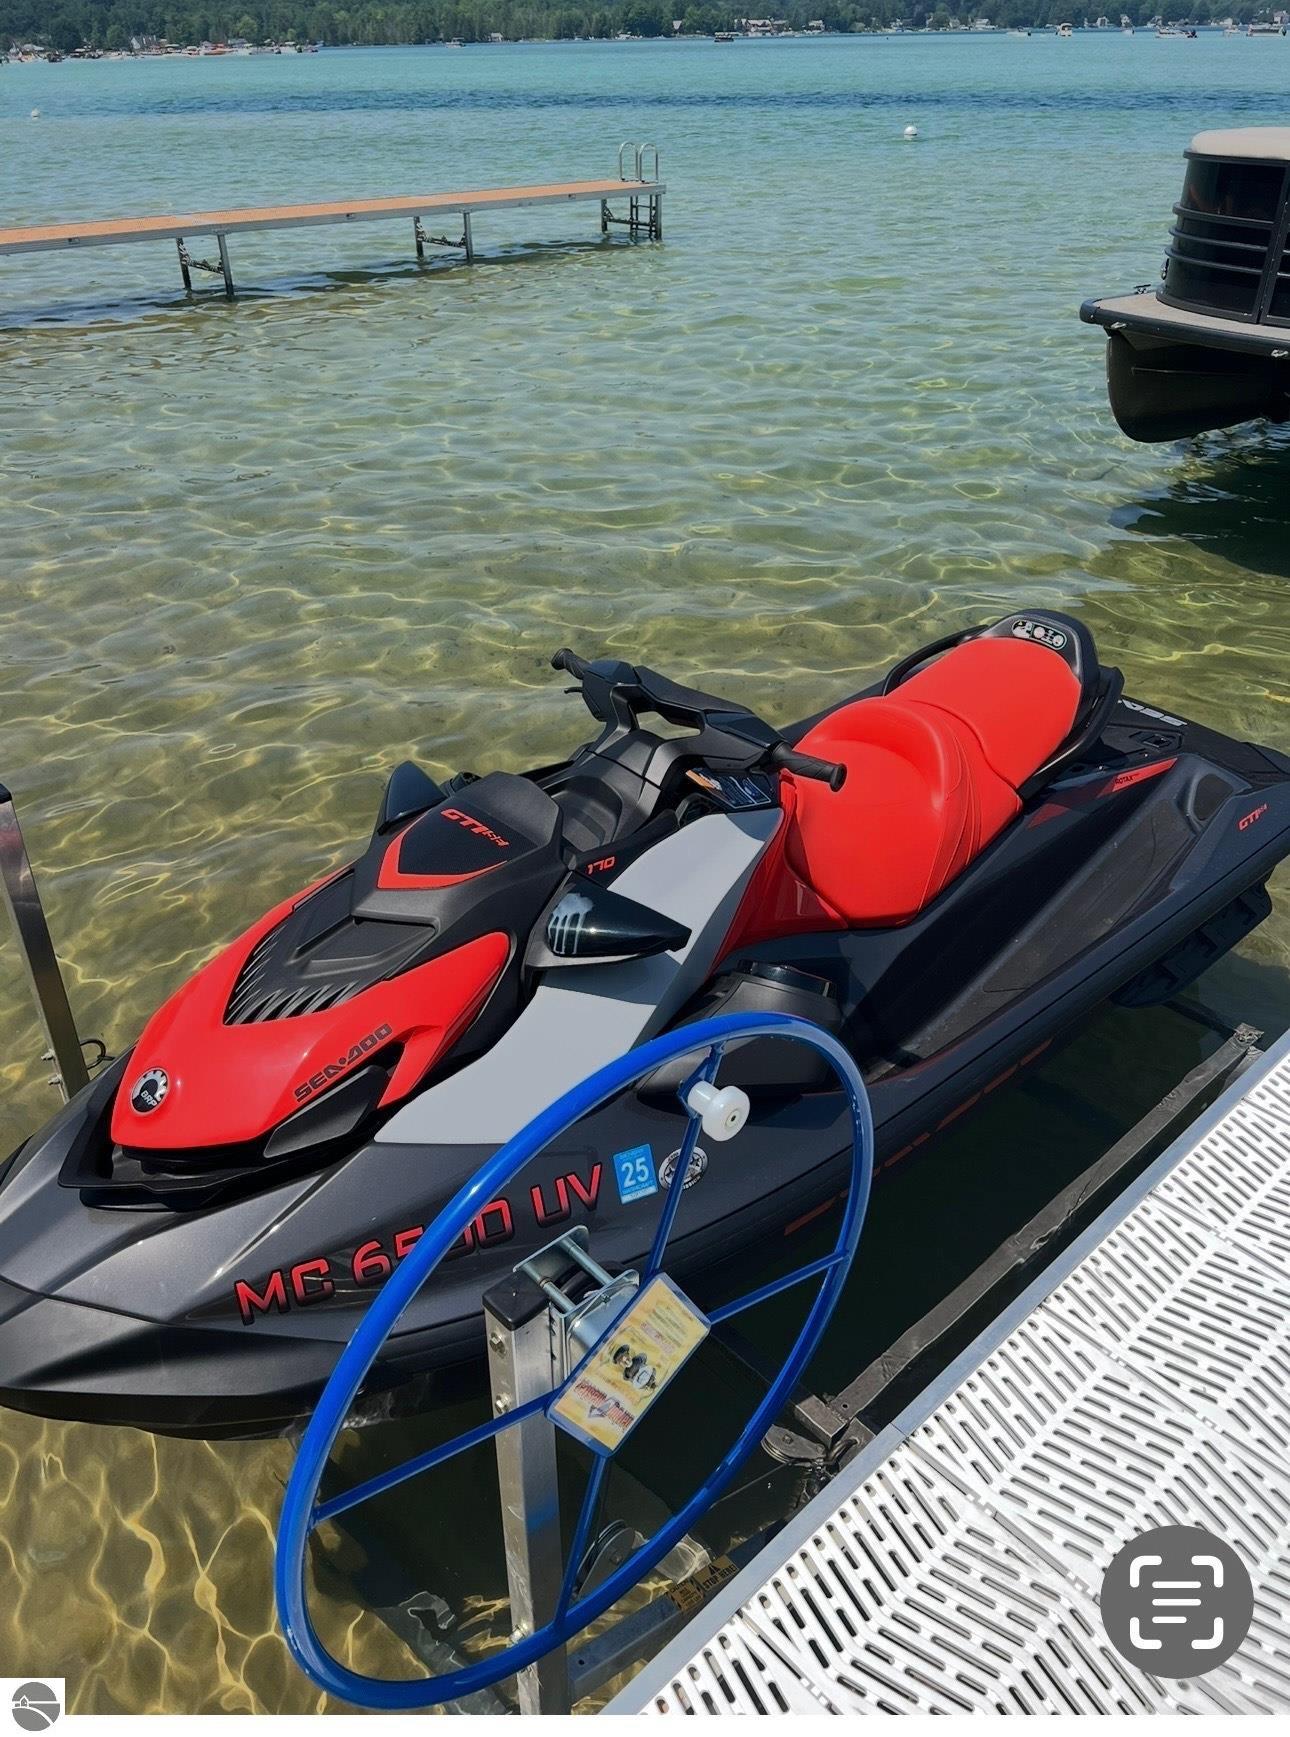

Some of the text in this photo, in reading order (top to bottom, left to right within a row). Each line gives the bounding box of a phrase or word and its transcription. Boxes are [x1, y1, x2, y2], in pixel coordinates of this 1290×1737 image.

[587, 856, 616, 875] 170
[140, 1089, 158, 1107] BRP
[621, 1157, 650, 1188] 25
[234, 1256, 335, 1326] MC
[530, 1162, 602, 1228] UV
